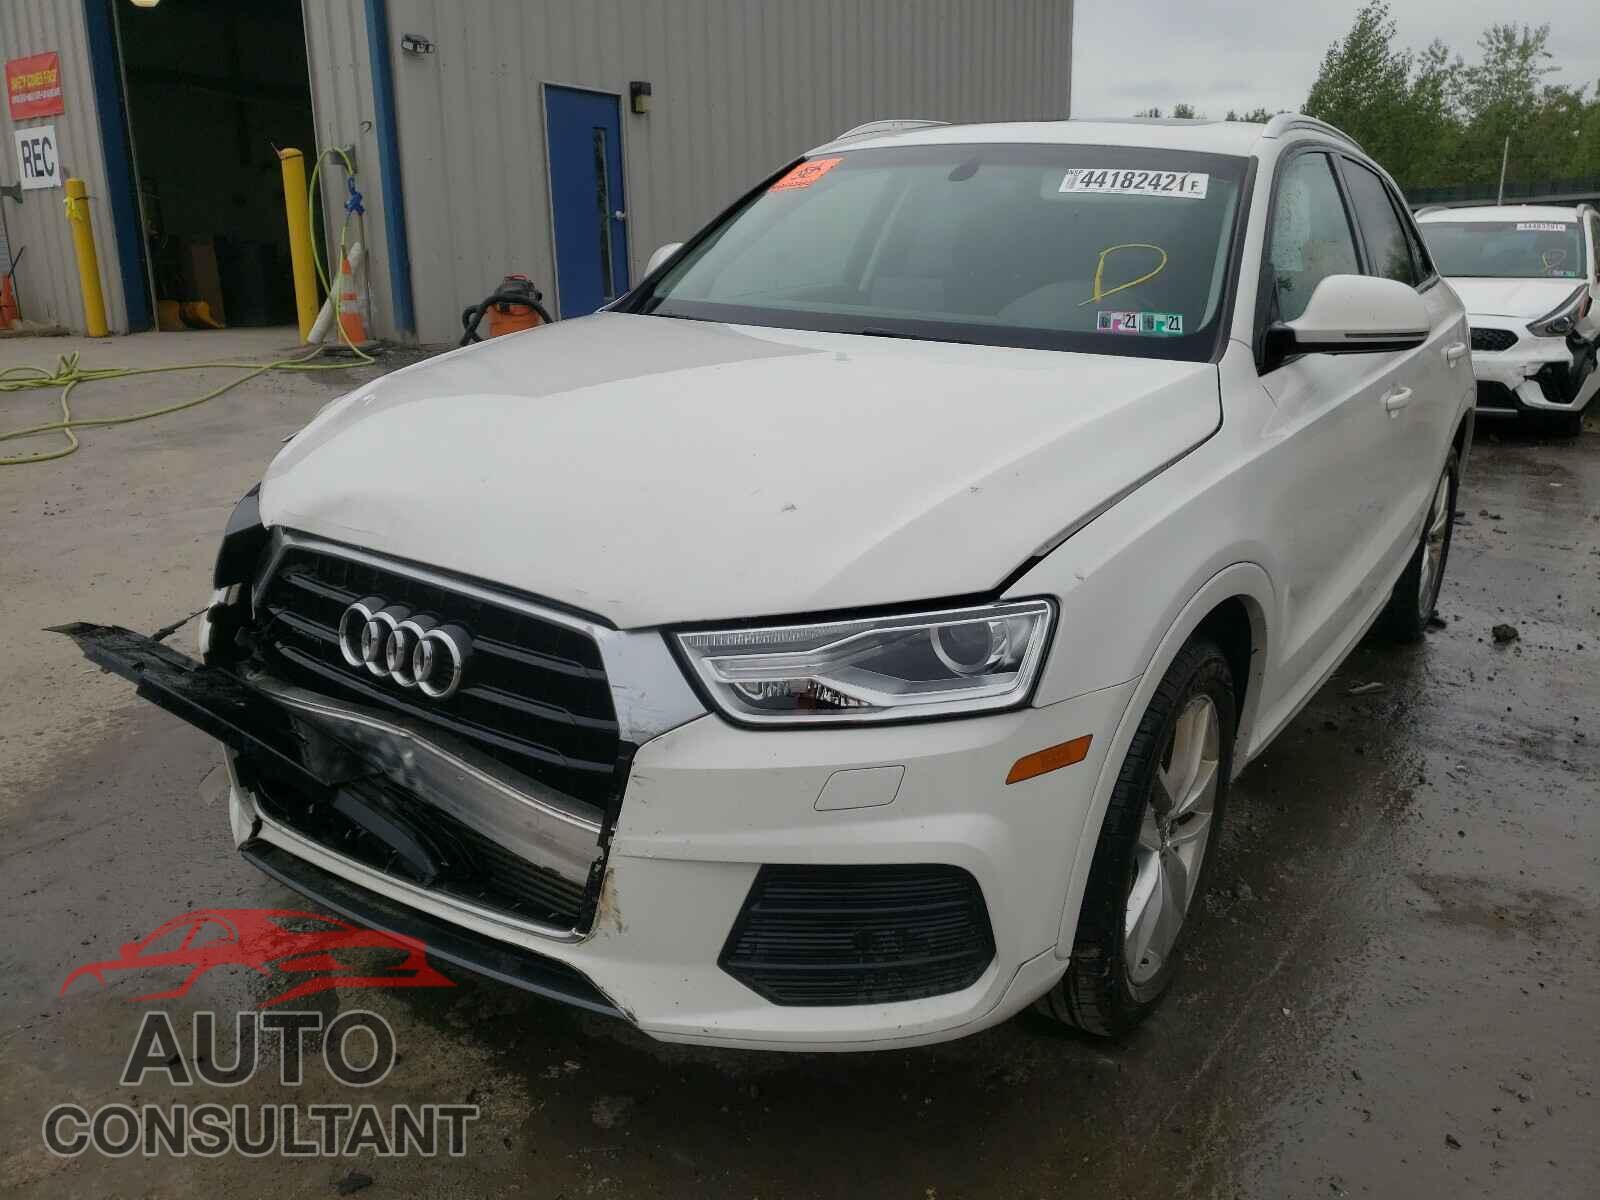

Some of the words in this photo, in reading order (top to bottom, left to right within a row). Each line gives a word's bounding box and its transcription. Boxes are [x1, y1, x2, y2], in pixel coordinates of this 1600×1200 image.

[21, 136, 54, 178] REC
[1080, 171, 1188, 192] 44182421
[1125, 314, 1137, 329] 21
[1168, 315, 1181, 331] 21
